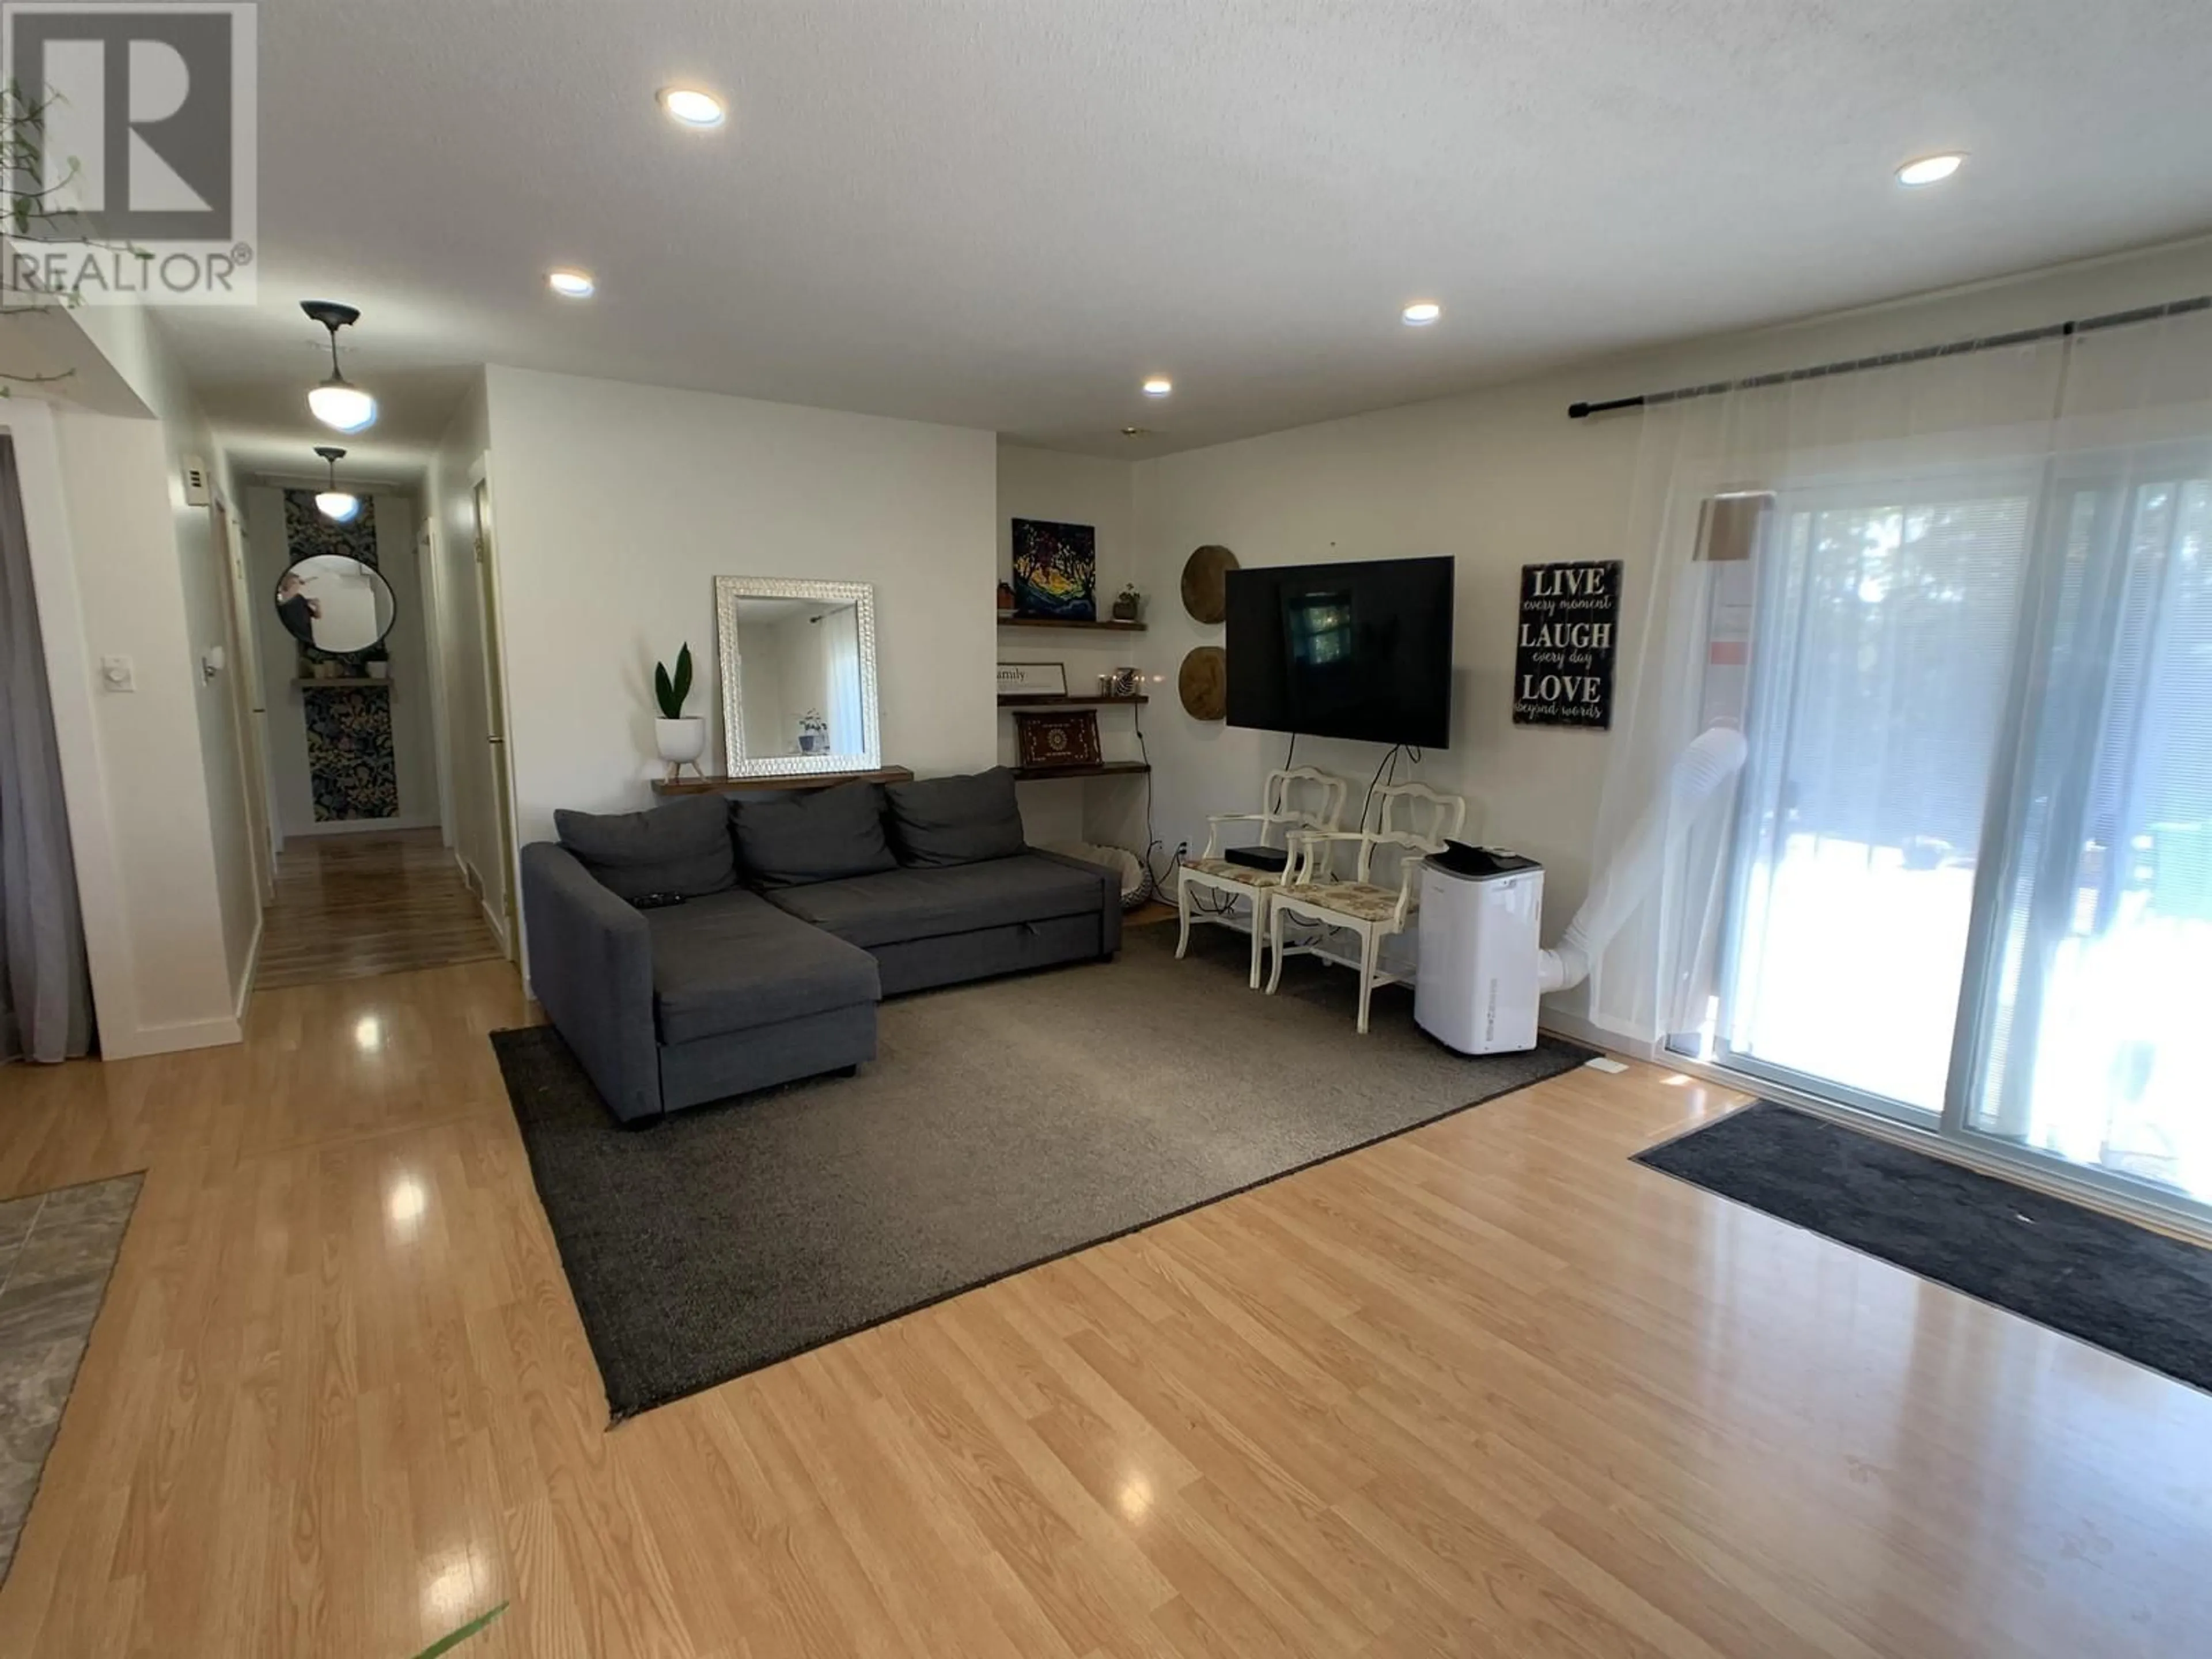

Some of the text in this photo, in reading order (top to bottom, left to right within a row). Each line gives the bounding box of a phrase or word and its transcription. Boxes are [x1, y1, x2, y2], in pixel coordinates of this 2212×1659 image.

[1533, 568, 1605, 596] LIVE
[1524, 596, 1612, 617] every moment
[1520, 623, 1612, 649] LAUGH
[1532, 649, 1592, 670] every day
[997, 668, 1025, 682] amily
[1522, 675, 1601, 703] LOVE
[1515, 700, 1603, 719] beyond words
